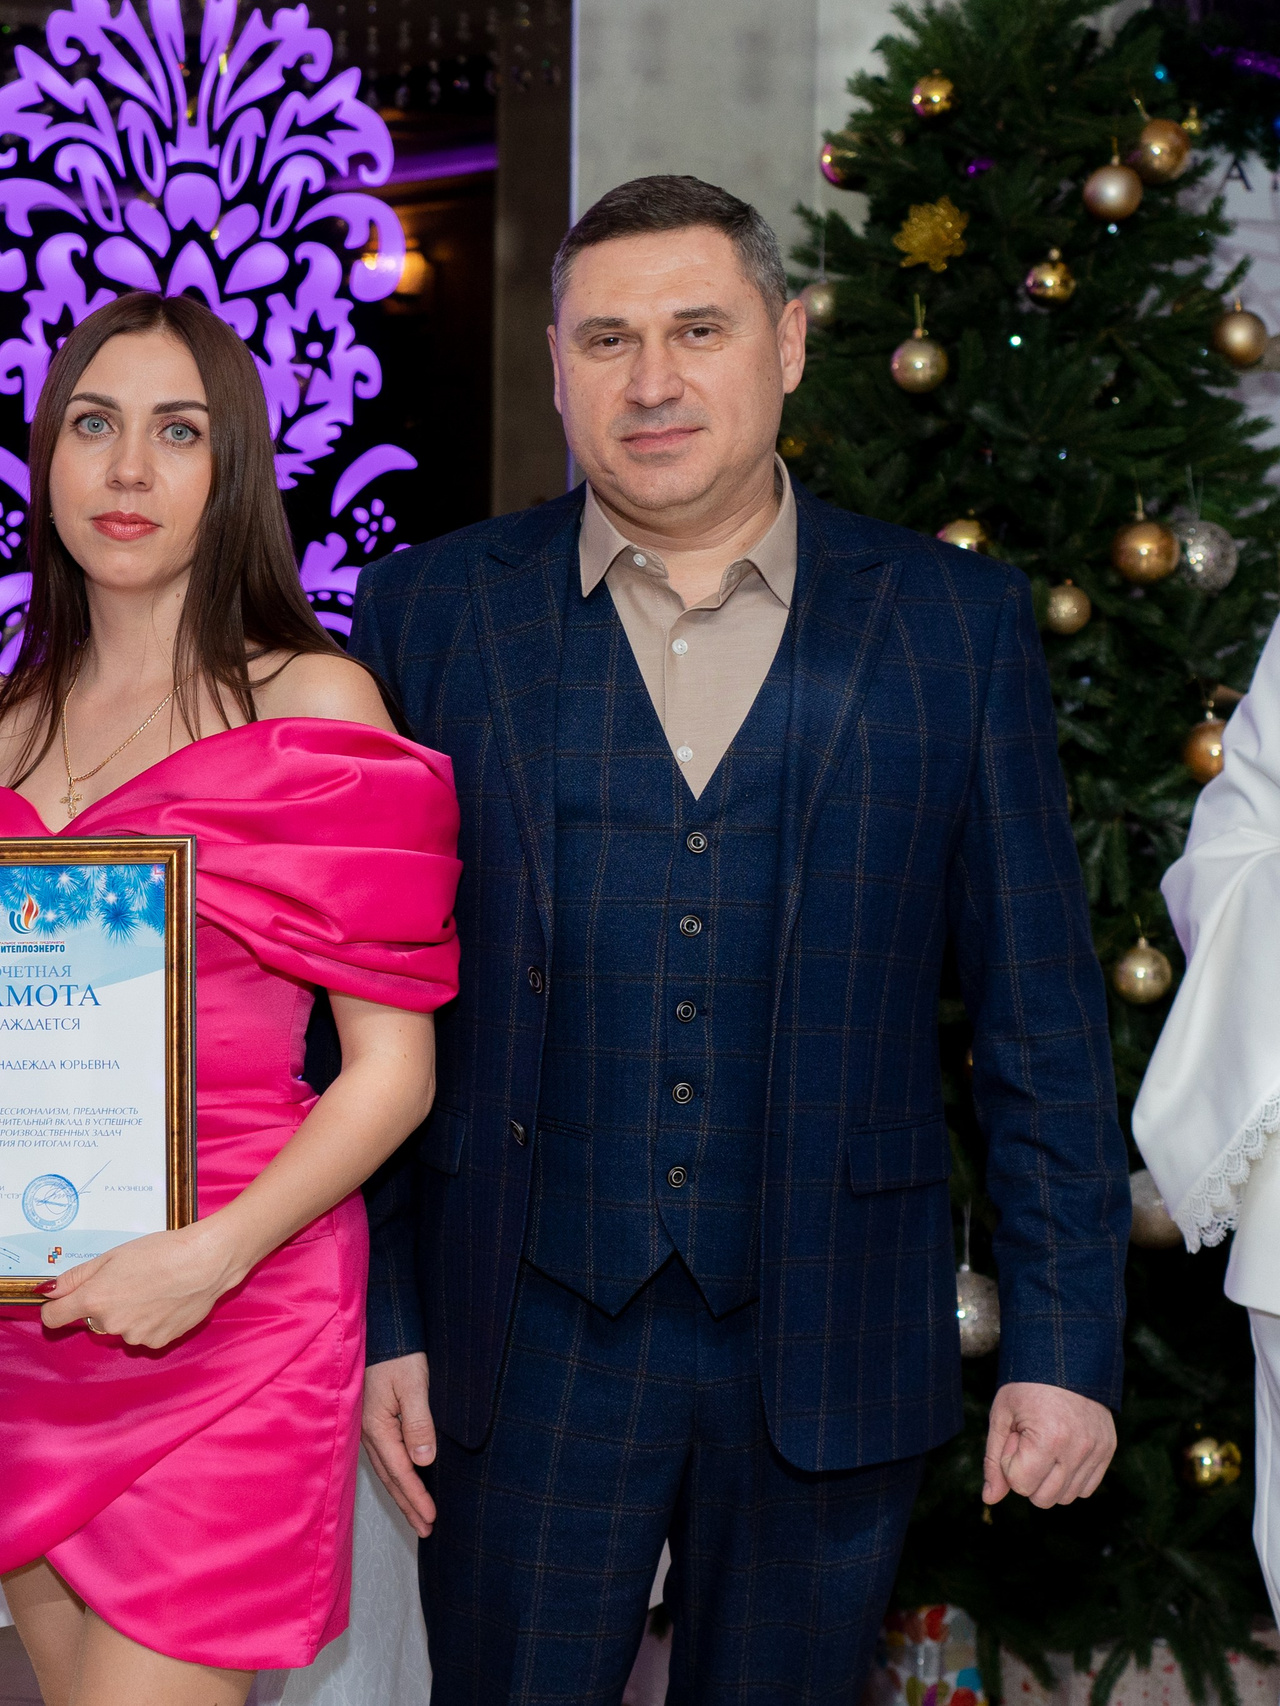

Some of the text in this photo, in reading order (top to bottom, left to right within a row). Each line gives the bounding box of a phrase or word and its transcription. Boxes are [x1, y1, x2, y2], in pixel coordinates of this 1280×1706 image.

[60, 1060, 120, 1070] ЮРЬЕВНА
[73, 1107, 139, 1115] ПРЕДАННОСТЬ
[54, 1118, 83, 1126] ВКЛАД
[85, 1118, 90, 1126] В
[93, 1118, 143, 1126] УСПЕШНОЕ
[93, 1129, 122, 1137] ЗАДАЧ
